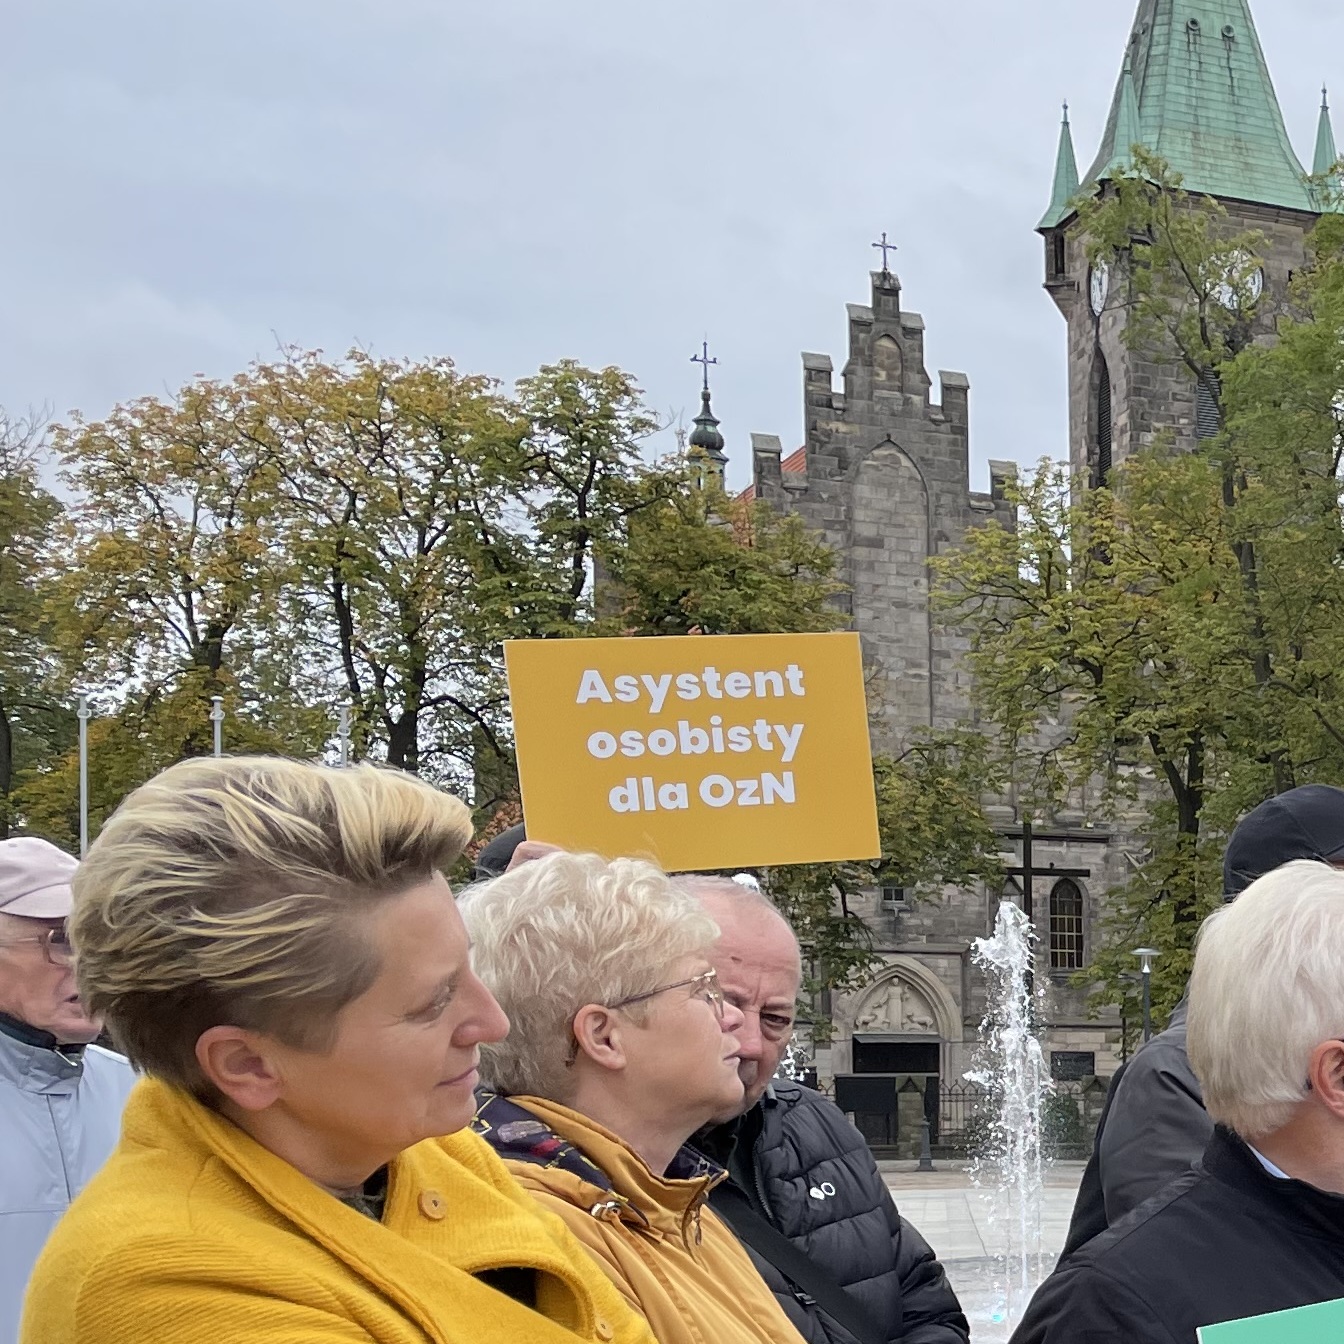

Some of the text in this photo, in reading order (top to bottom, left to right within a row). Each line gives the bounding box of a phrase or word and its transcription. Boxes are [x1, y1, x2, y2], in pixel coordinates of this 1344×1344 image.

[576, 664, 806, 714] Asystent
[586, 715, 805, 763] osobisty
[608, 771, 796, 813] dla OzN
